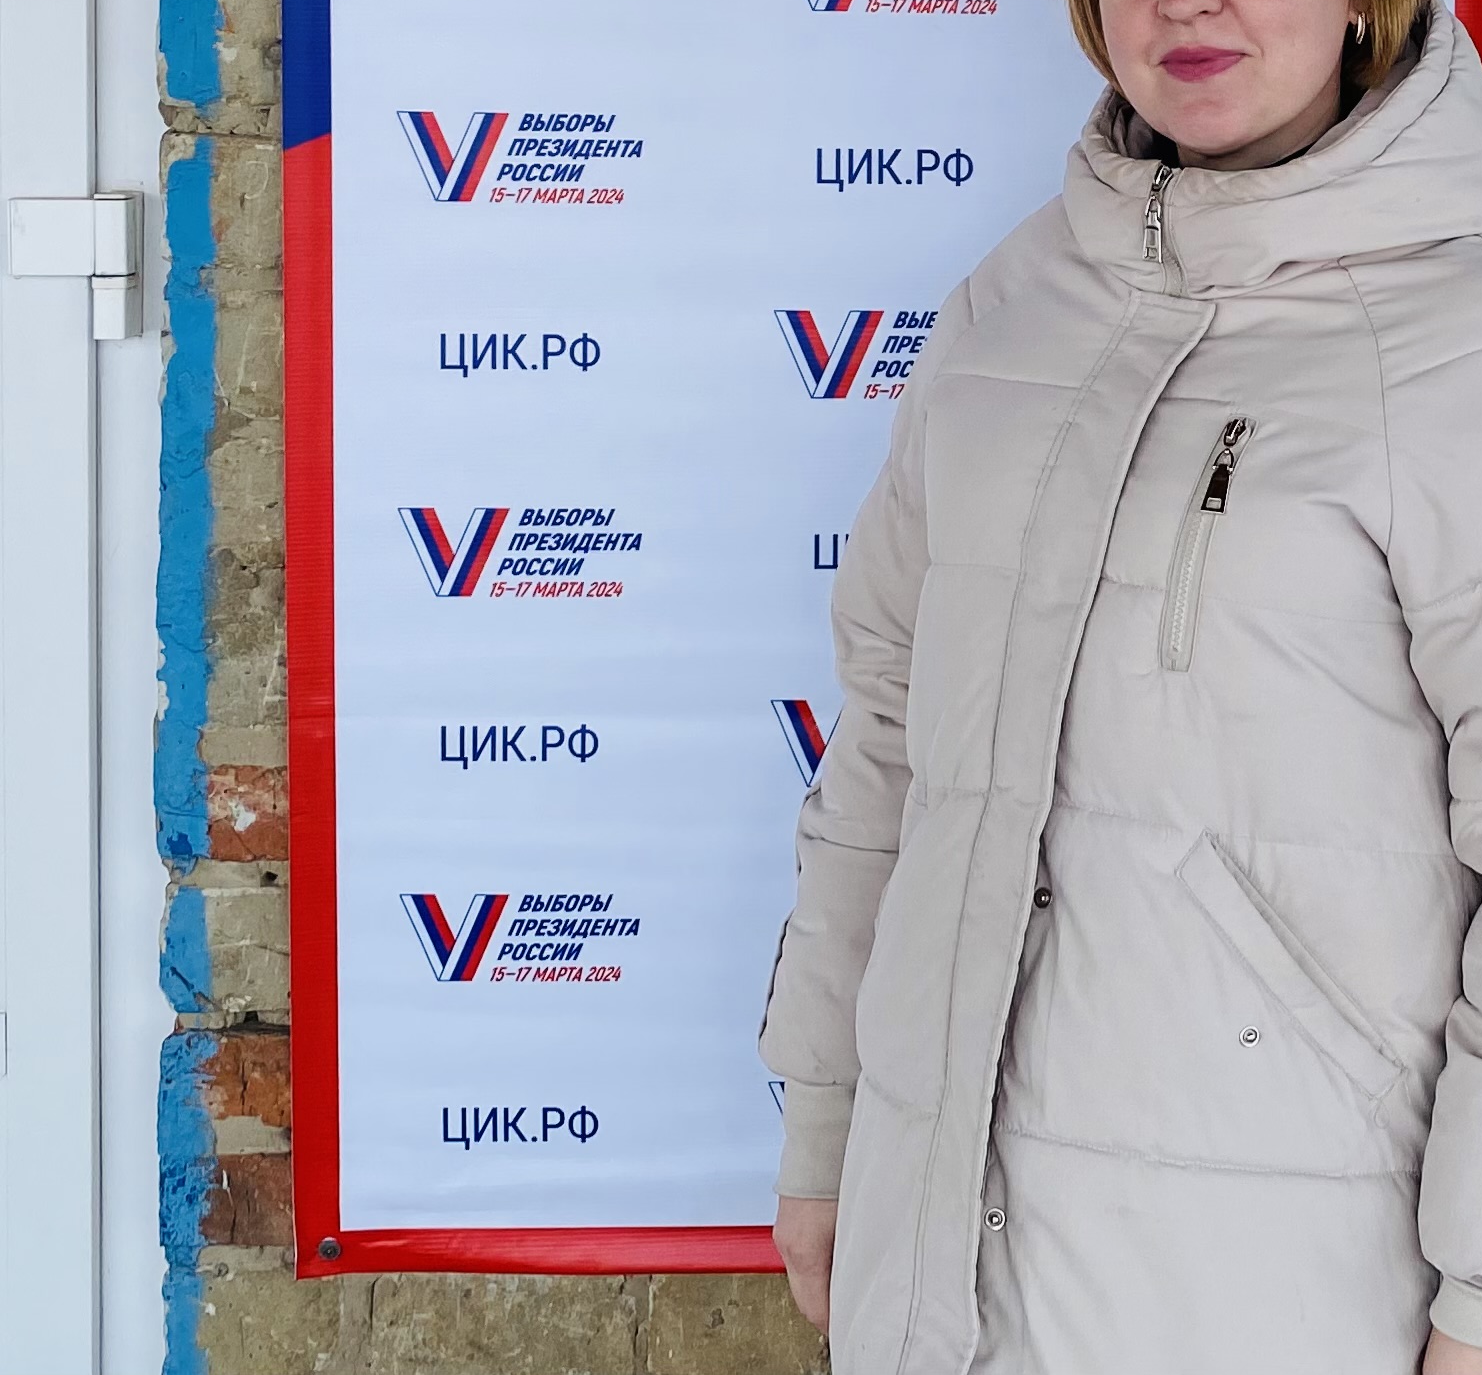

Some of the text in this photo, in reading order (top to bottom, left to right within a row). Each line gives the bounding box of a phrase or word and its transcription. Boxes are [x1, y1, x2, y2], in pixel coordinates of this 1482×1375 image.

[961, 0, 997, 15] 2024
[518, 113, 616, 132] ВЫБОРЫ
[508, 139, 643, 160] ПРЕЗИДЕНТА
[497, 163, 585, 182] РОССИИ
[817, 148, 973, 192] ЦИК.РФ
[532, 188, 584, 204] МАРТА
[587, 189, 624, 204] 2024
[440, 333, 600, 378] ЦИК.РФ
[872, 361, 911, 378] РОС
[518, 508, 615, 526] ВЫБОРЫ
[508, 533, 642, 554] ПРЕЗИДЕНТА
[497, 558, 584, 576] РОССИИ
[532, 582, 584, 597] МАРТА
[586, 582, 623, 597] 2024
[441, 724, 598, 770] ЦИК.РФ
[518, 894, 613, 912] ВЫБОРЫ
[508, 919, 640, 939] ПРЕЗИДЕНТА
[497, 943, 583, 961] РОССИИ
[532, 967, 583, 982] МАРТА
[585, 966, 621, 982] 2024
[443, 1105, 598, 1150] ЦИК.РФ
